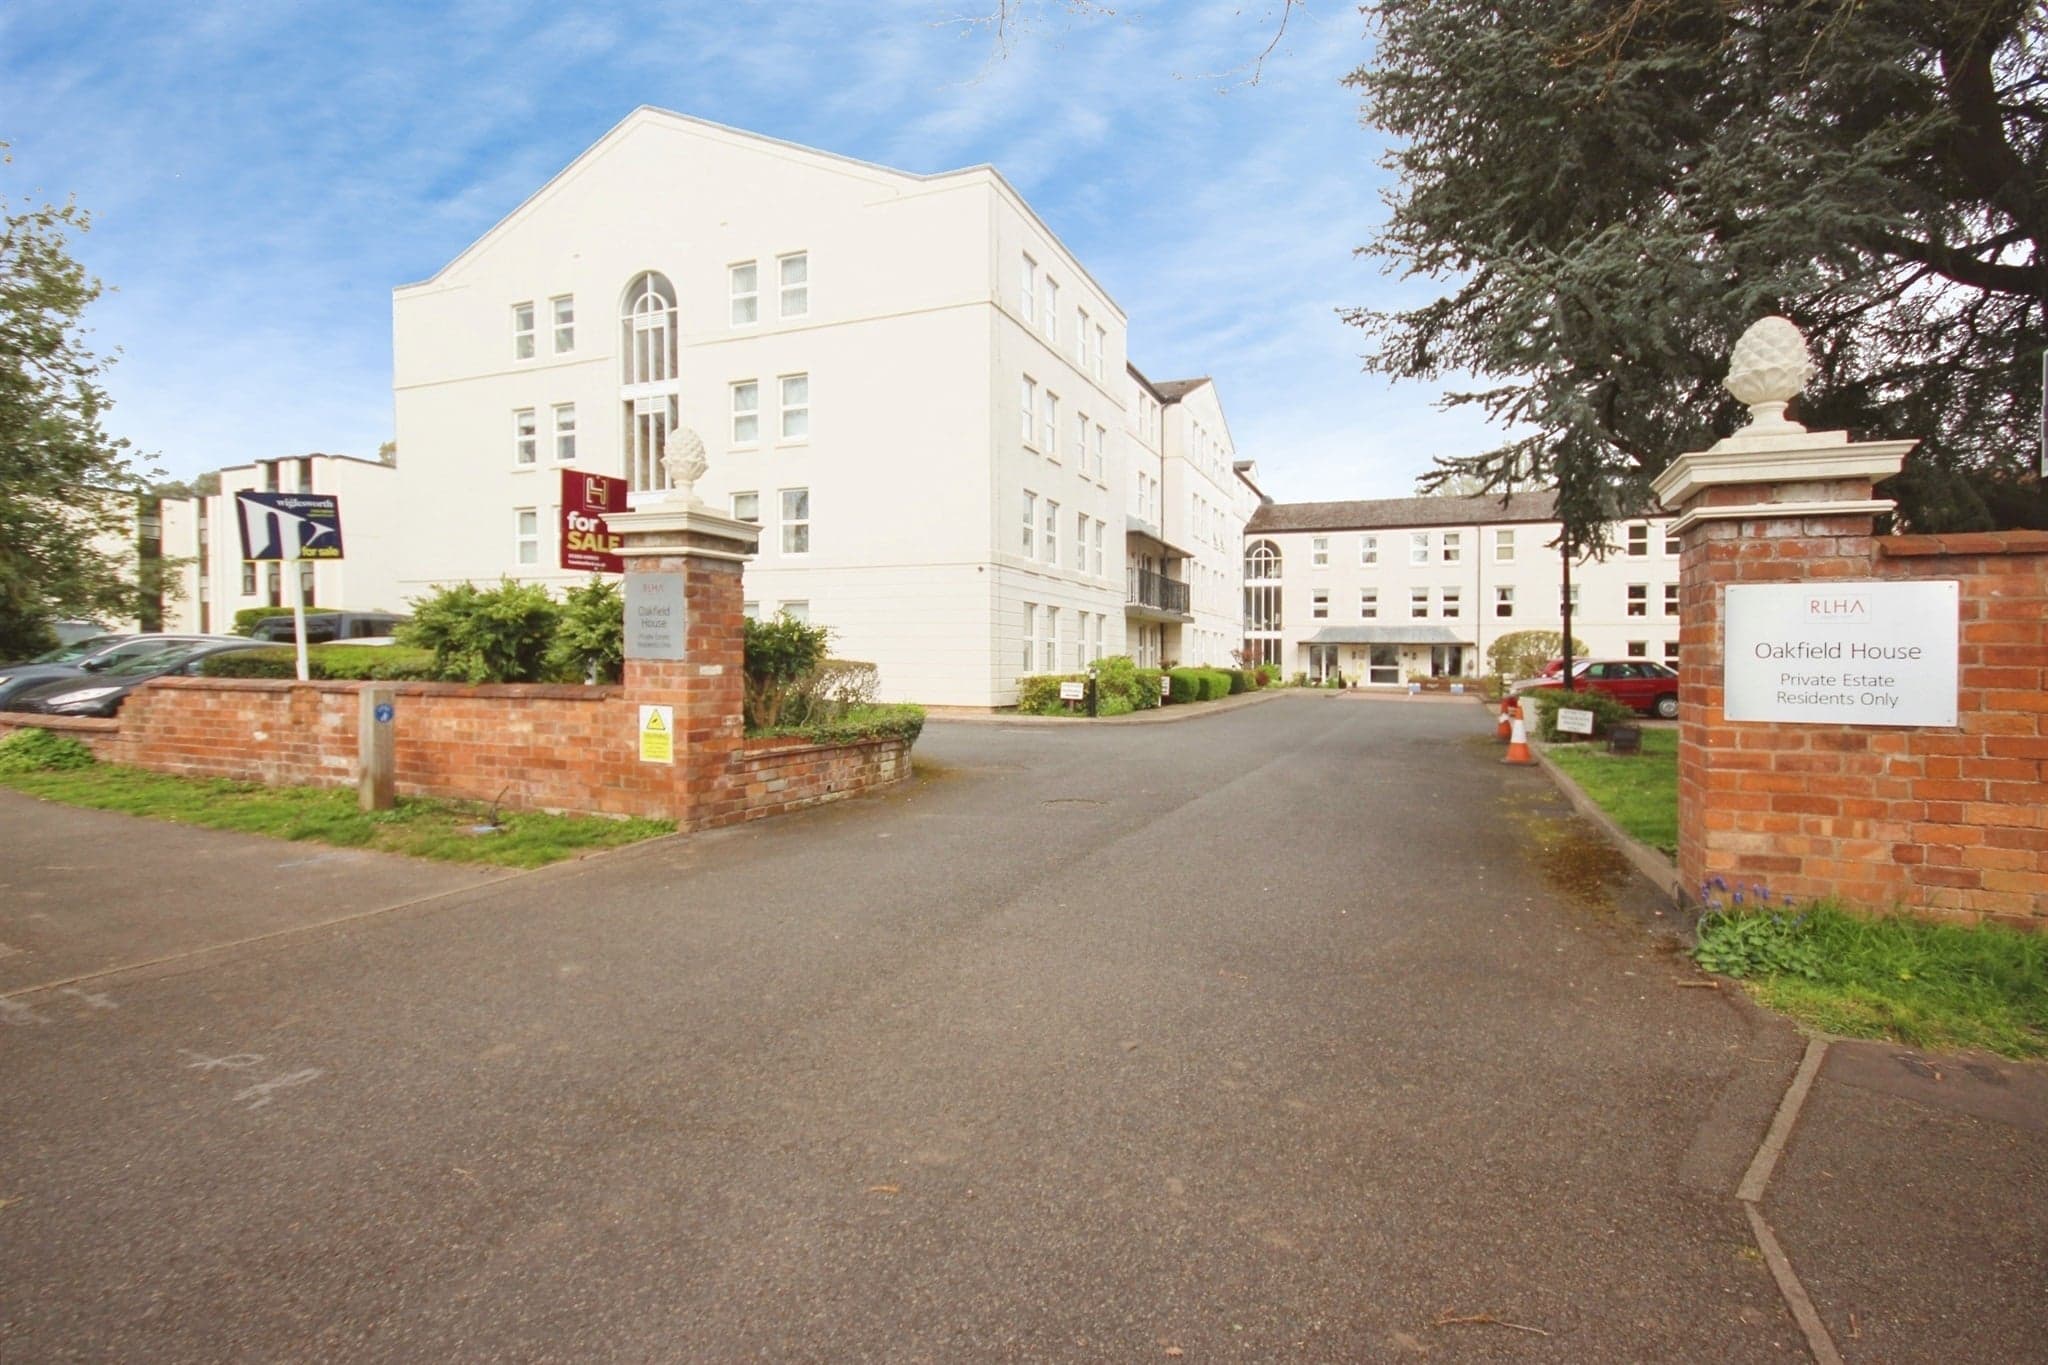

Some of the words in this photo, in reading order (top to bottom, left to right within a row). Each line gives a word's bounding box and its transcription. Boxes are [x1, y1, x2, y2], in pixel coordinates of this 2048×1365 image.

[566, 511, 599, 532] for
[567, 530, 620, 553] SALE
[301, 546, 317, 557] for
[318, 546, 340, 557] sale
[1810, 599, 1865, 614] RLHA
[641, 618, 667, 629] House
[1755, 641, 1841, 660] Oakfield
[1851, 643, 1922, 660] House
[1780, 673, 1837, 687] Private
[1843, 673, 1895, 687] Estate
[1777, 691, 1854, 706] Residents
[1860, 692, 1899, 709] Only
